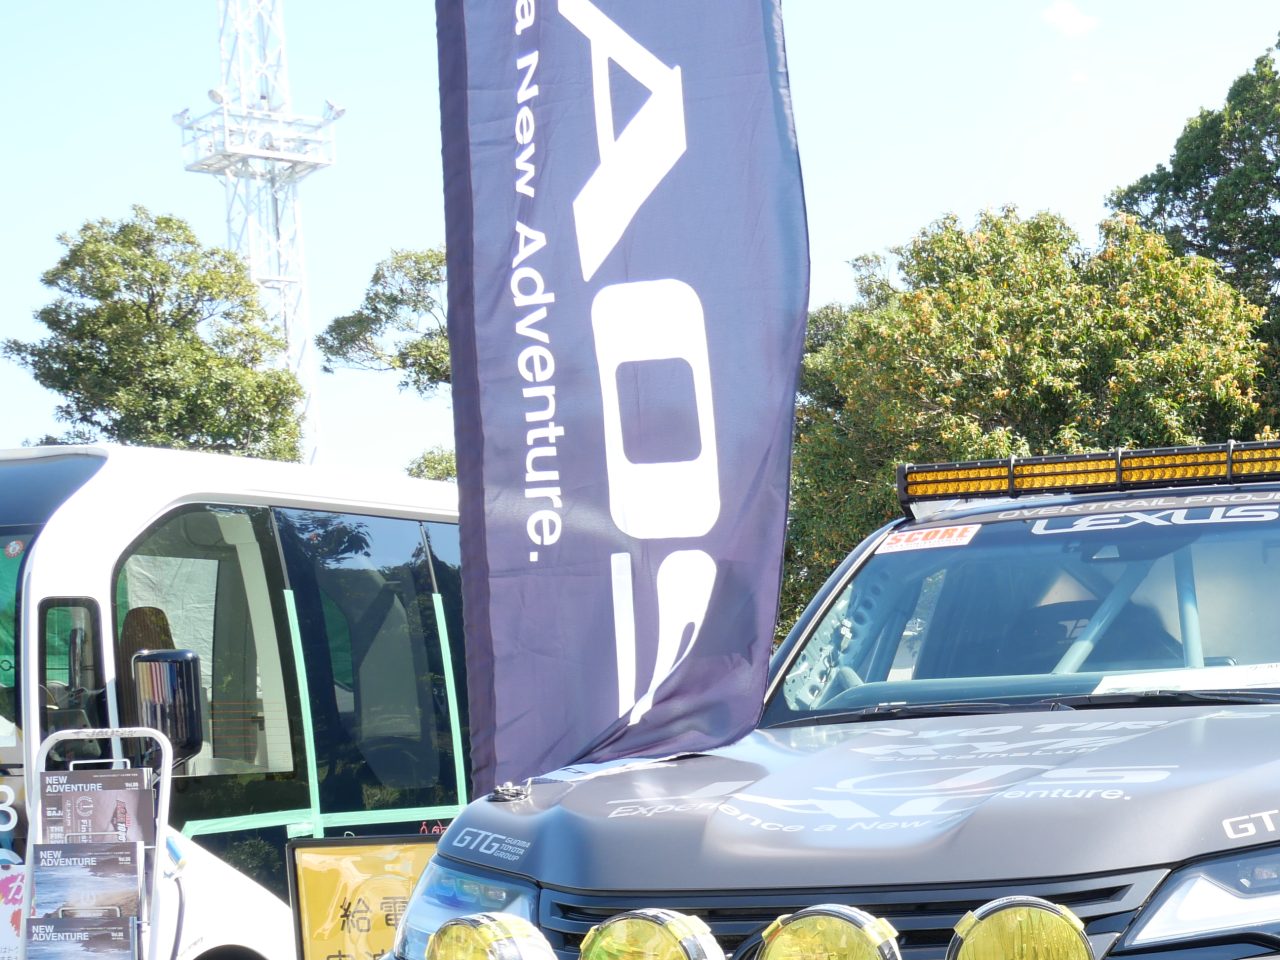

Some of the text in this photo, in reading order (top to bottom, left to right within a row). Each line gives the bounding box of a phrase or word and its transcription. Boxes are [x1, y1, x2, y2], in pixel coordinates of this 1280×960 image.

[515, 50, 540, 198] New
[511, 221, 565, 562] Adventure.
[1031, 504, 1280, 535] LEXUS
[886, 525, 972, 547] SCORE
[46, 776, 67, 785] NEW
[46, 783, 103, 793] ADVENTURE
[846, 820, 930, 832] New
[452, 827, 506, 855] GTG
[40, 850, 62, 859] NEW
[500, 843, 525, 855] TOYOTA
[493, 850, 519, 861] GROUP
[40, 858, 96, 866] ADVENTURE
[32, 925, 54, 933] NEW
[32, 932, 89, 941] ADVENTURE
